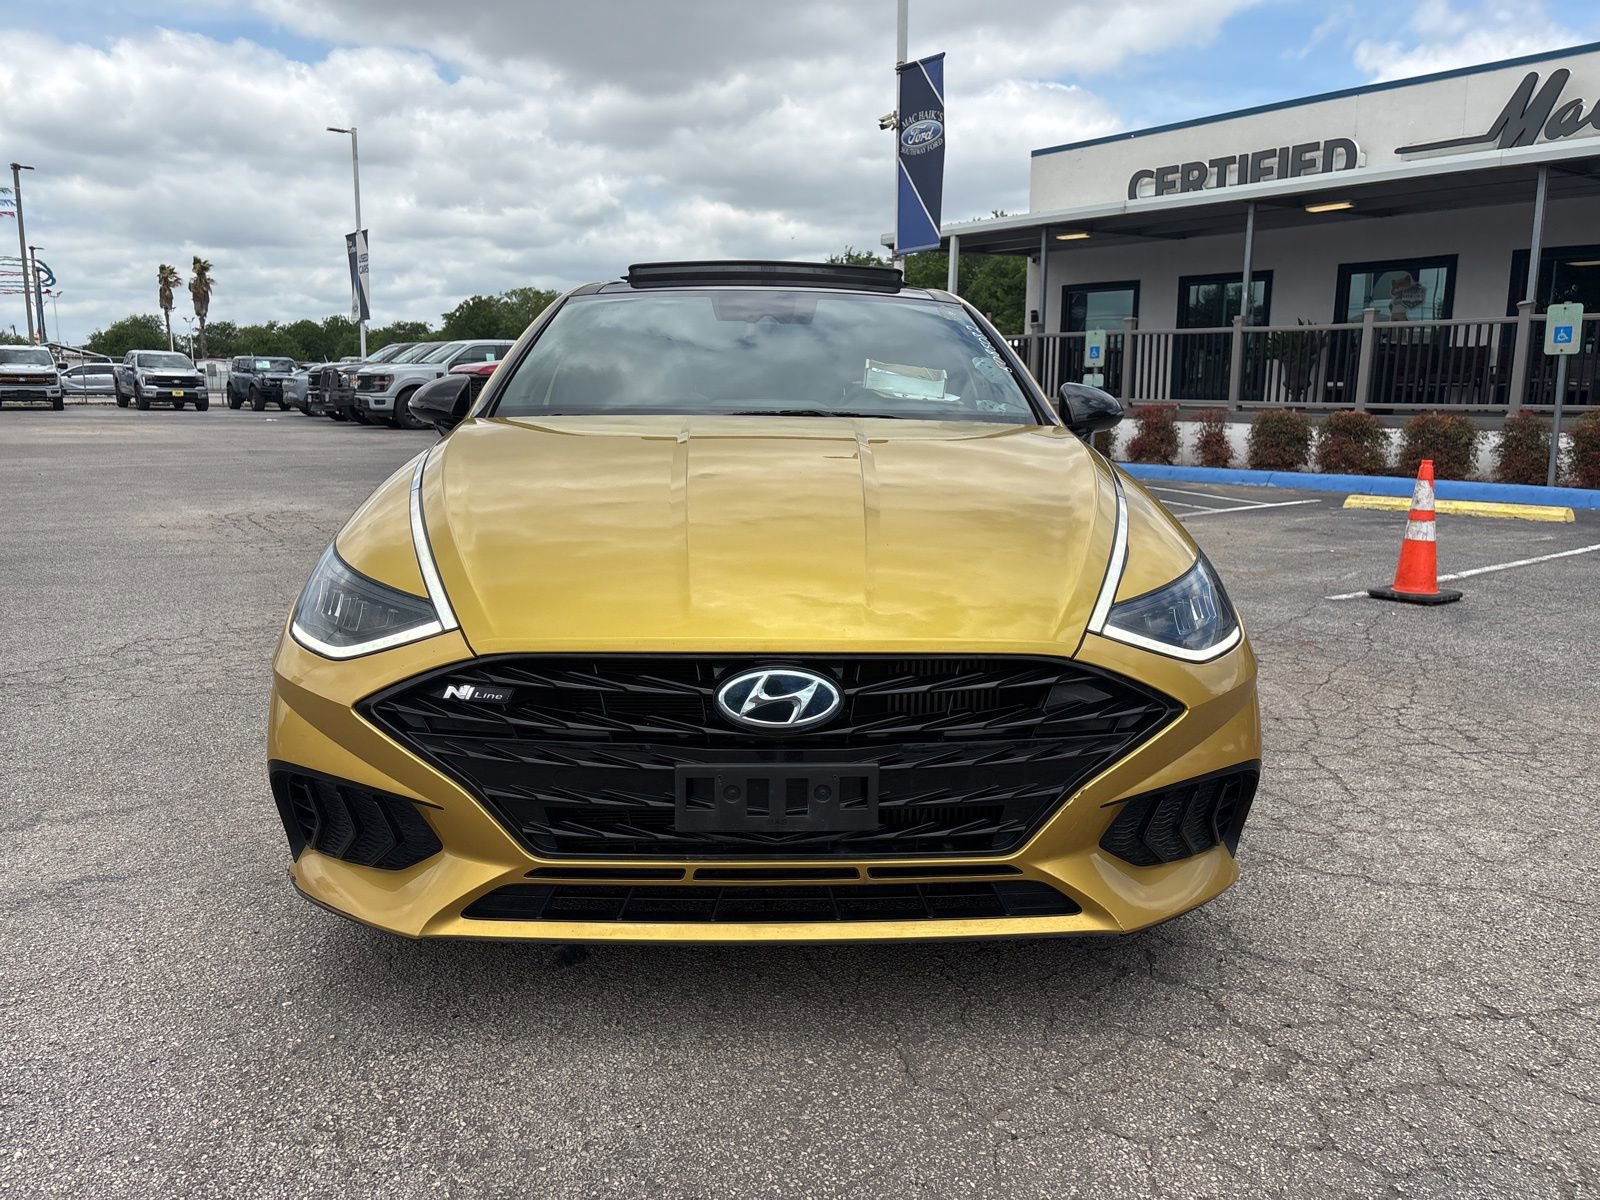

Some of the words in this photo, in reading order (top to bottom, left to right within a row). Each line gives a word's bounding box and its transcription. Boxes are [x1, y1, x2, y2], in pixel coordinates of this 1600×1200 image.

[901, 112, 918, 129] MAC
[918, 110, 944, 121] HAIK'S
[908, 124, 934, 144] Ford
[927, 138, 944, 151] FORD
[1127, 137, 1358, 200] CERTIFIED
[474, 691, 503, 700] Line
